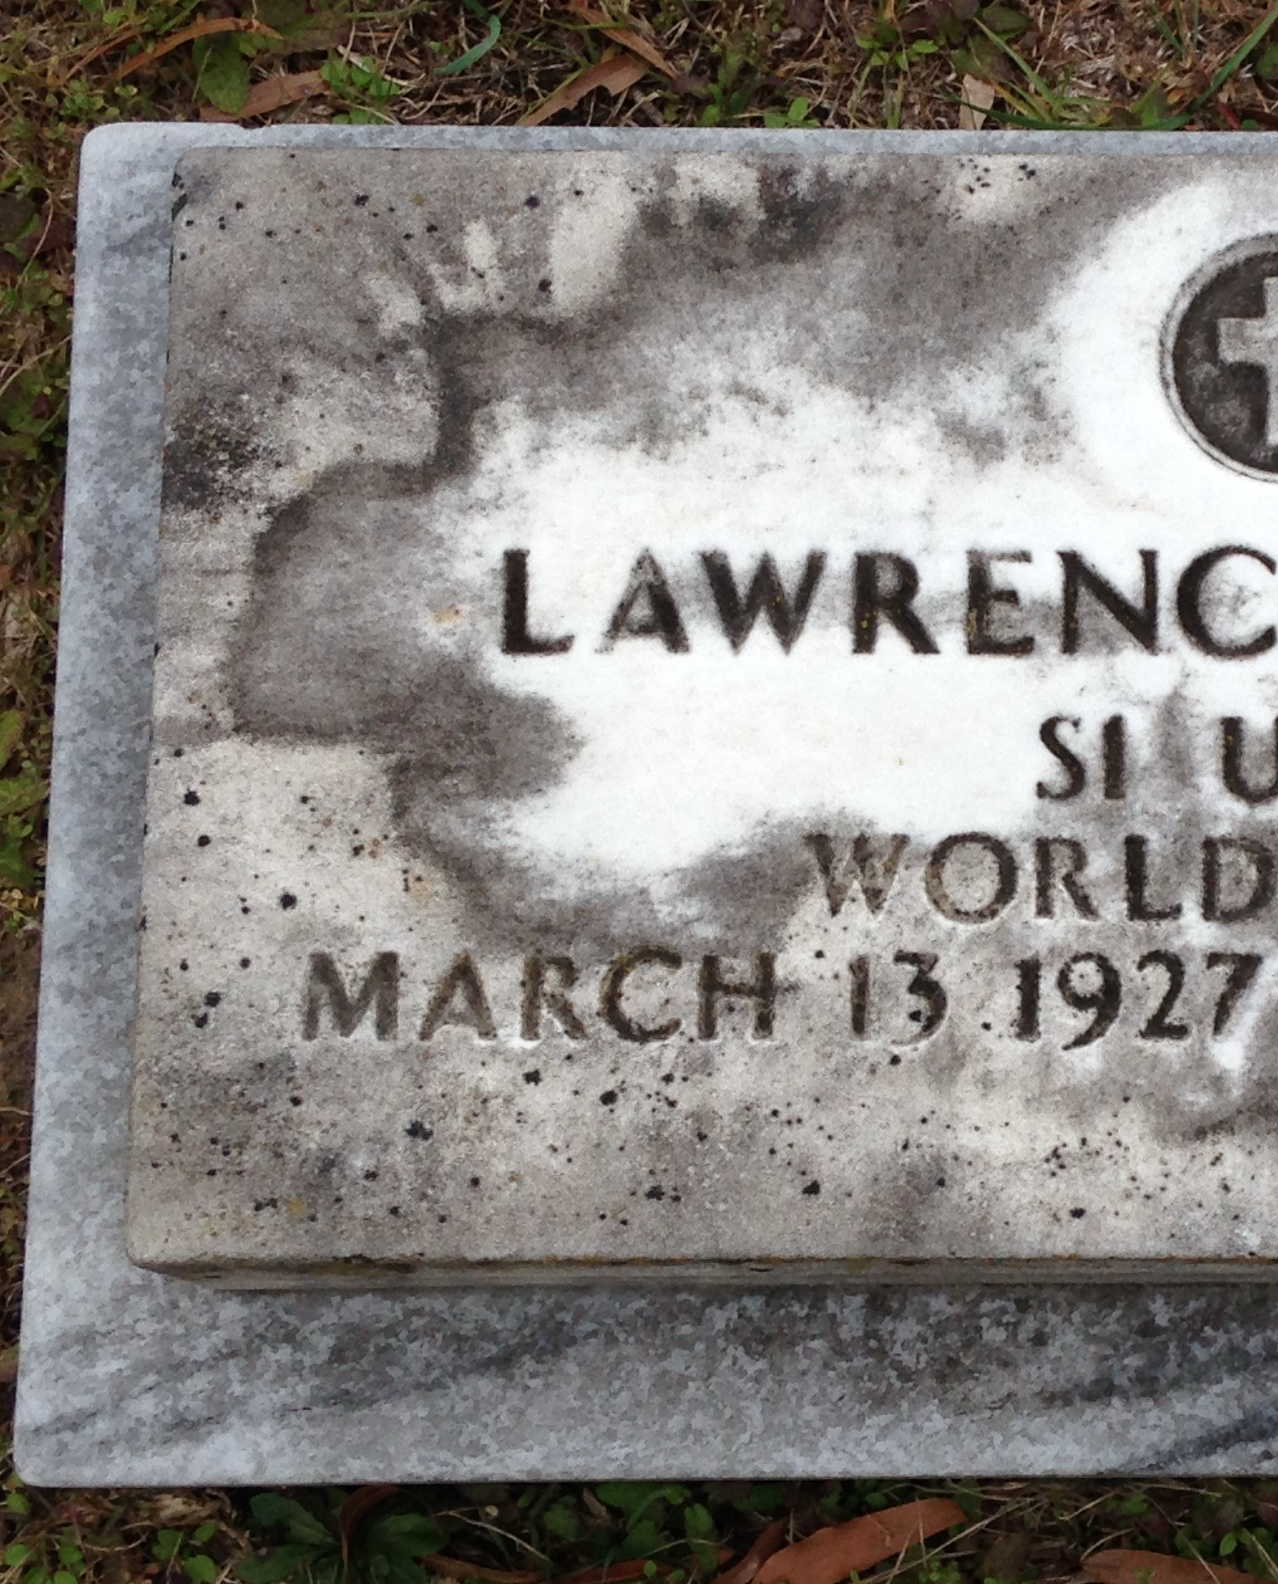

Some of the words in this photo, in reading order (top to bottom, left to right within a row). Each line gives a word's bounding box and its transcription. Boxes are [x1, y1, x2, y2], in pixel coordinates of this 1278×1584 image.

[807, 831, 1277, 924] WORLD
[299, 944, 776, 1044] MARCH
[849, 949, 949, 1047] 13
[1011, 948, 1266, 1052] 1927
